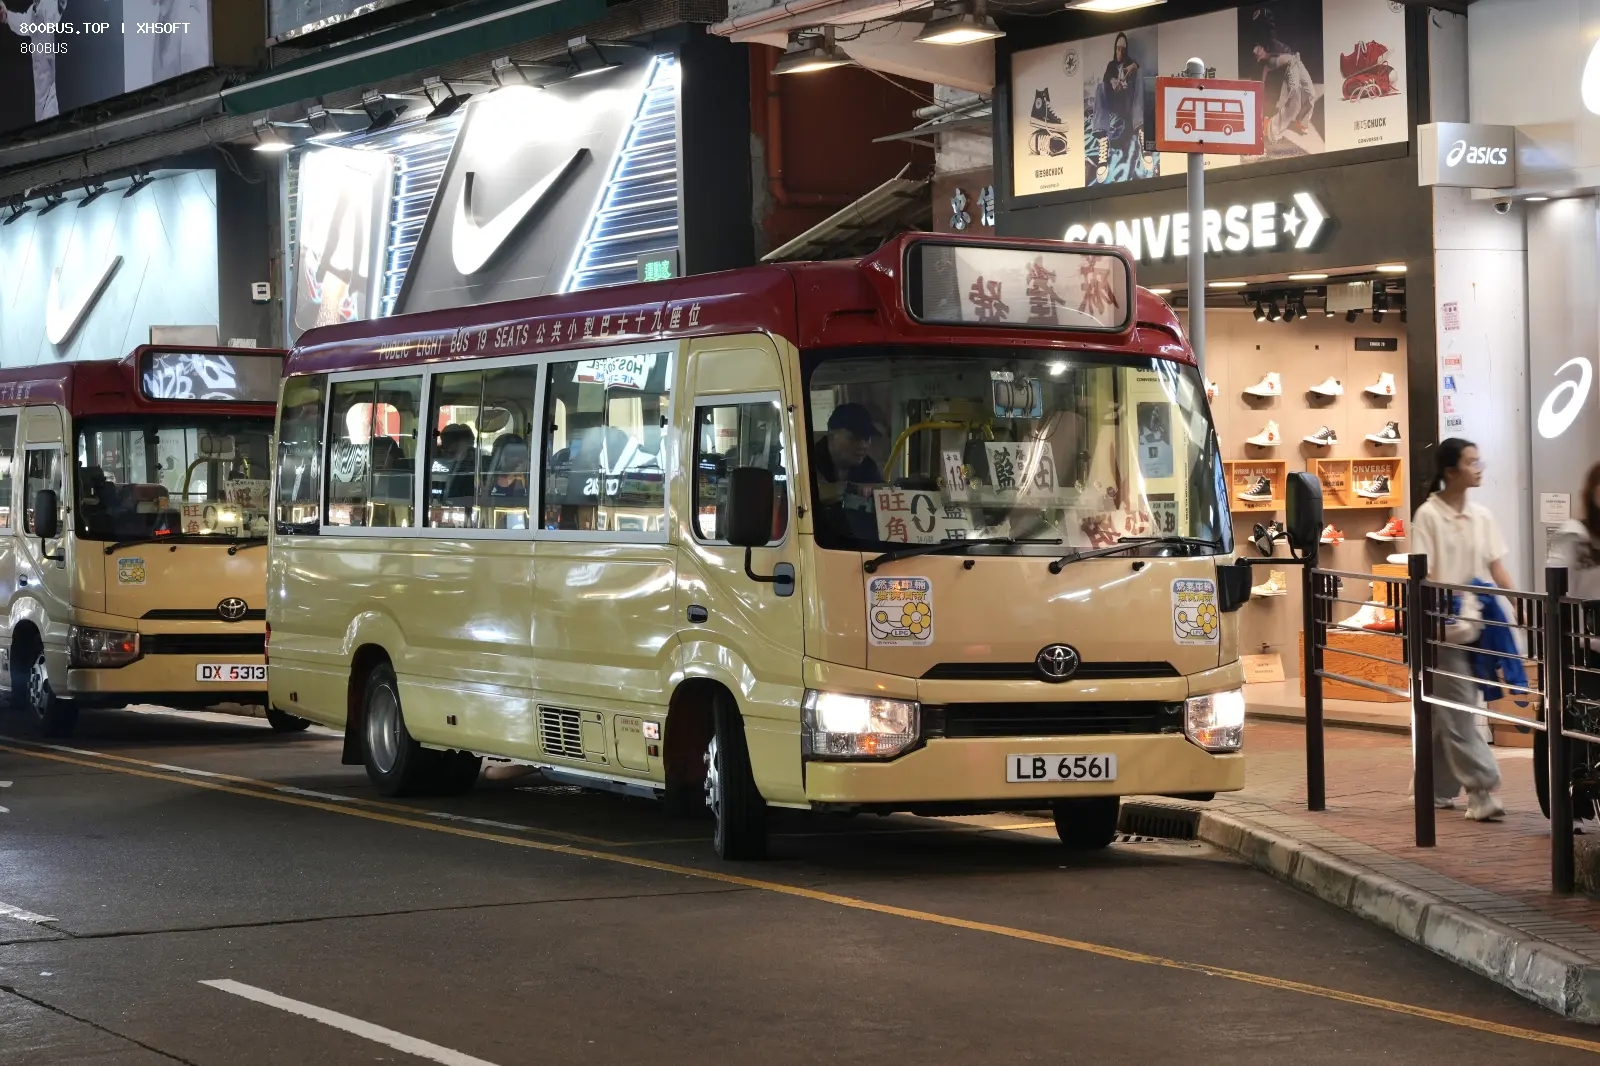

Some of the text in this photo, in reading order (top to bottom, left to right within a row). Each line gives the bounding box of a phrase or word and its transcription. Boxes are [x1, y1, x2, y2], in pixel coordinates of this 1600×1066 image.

[1466, 146, 1508, 165] asics
[379, 302, 701, 361] PUBLIC LIGHT BUS 19 SEATS 公共小型巴士十九座位
[879, 493, 910, 544] 旺角
[202, 665, 266, 680] DX 5313
[1016, 756, 1110, 779] LB 6561
